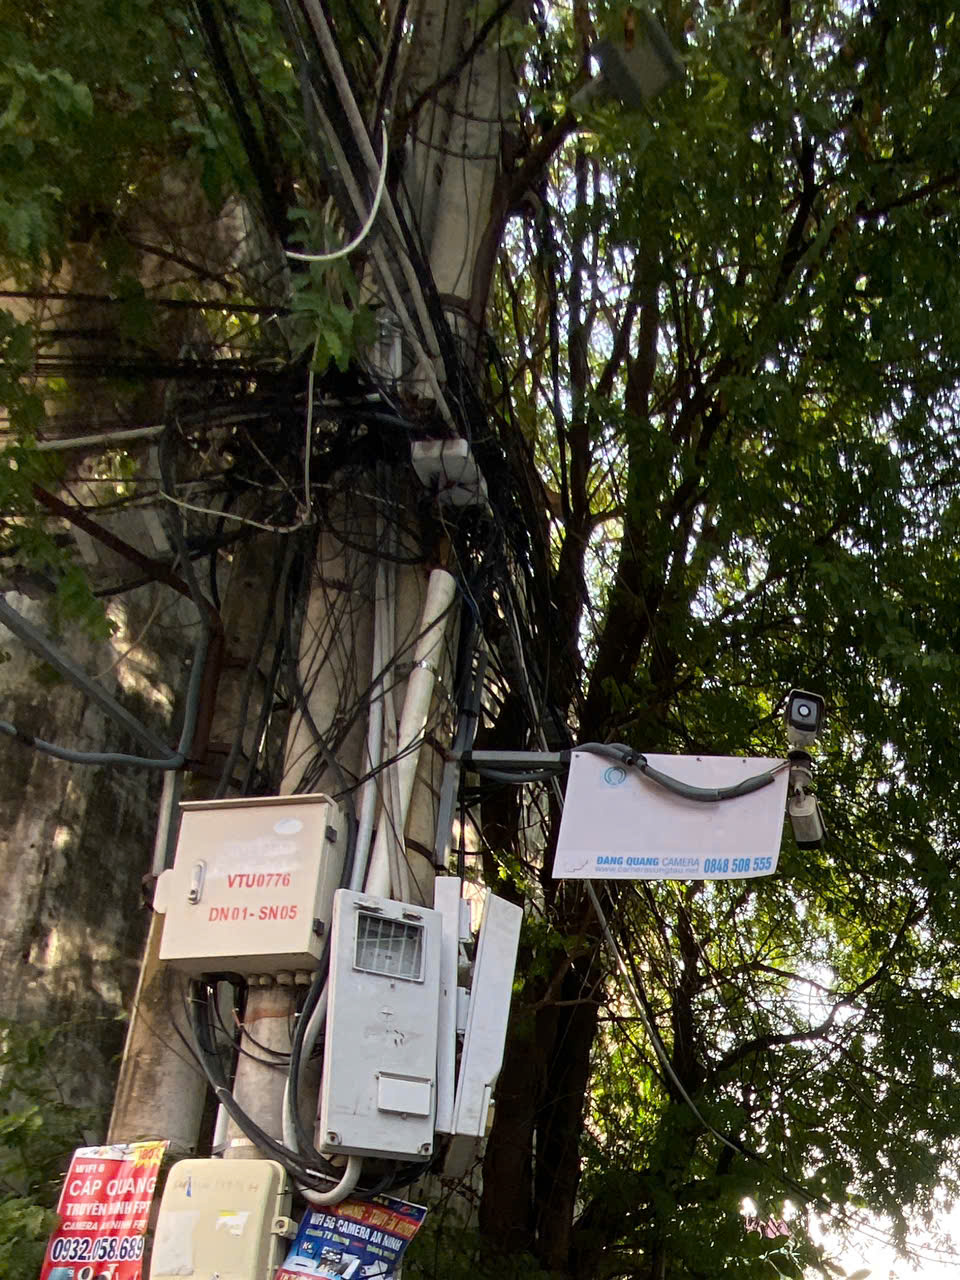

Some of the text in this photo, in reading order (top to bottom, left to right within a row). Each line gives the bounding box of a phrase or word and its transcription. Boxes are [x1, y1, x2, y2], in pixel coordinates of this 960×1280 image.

[626, 856, 660, 867] QUANG
[661, 857, 700, 867] CAMERA
[703, 856, 773, 874] 0848 508 555
[227, 873, 291, 889] VTU0776
[69, 1176, 103, 1197] CÁP
[106, 1176, 157, 1197] QUANG
[133, 1200, 152, 1214] FPT
[62, 1221, 99, 1232] CAMERA
[323, 1216, 336, 1229] 5G
[337, 1219, 371, 1240] CAMERA
[370, 1230, 383, 1244] AN
[382, 1235, 403, 1251] NINH
[52, 1236, 145, 1262] 0932.058.689
